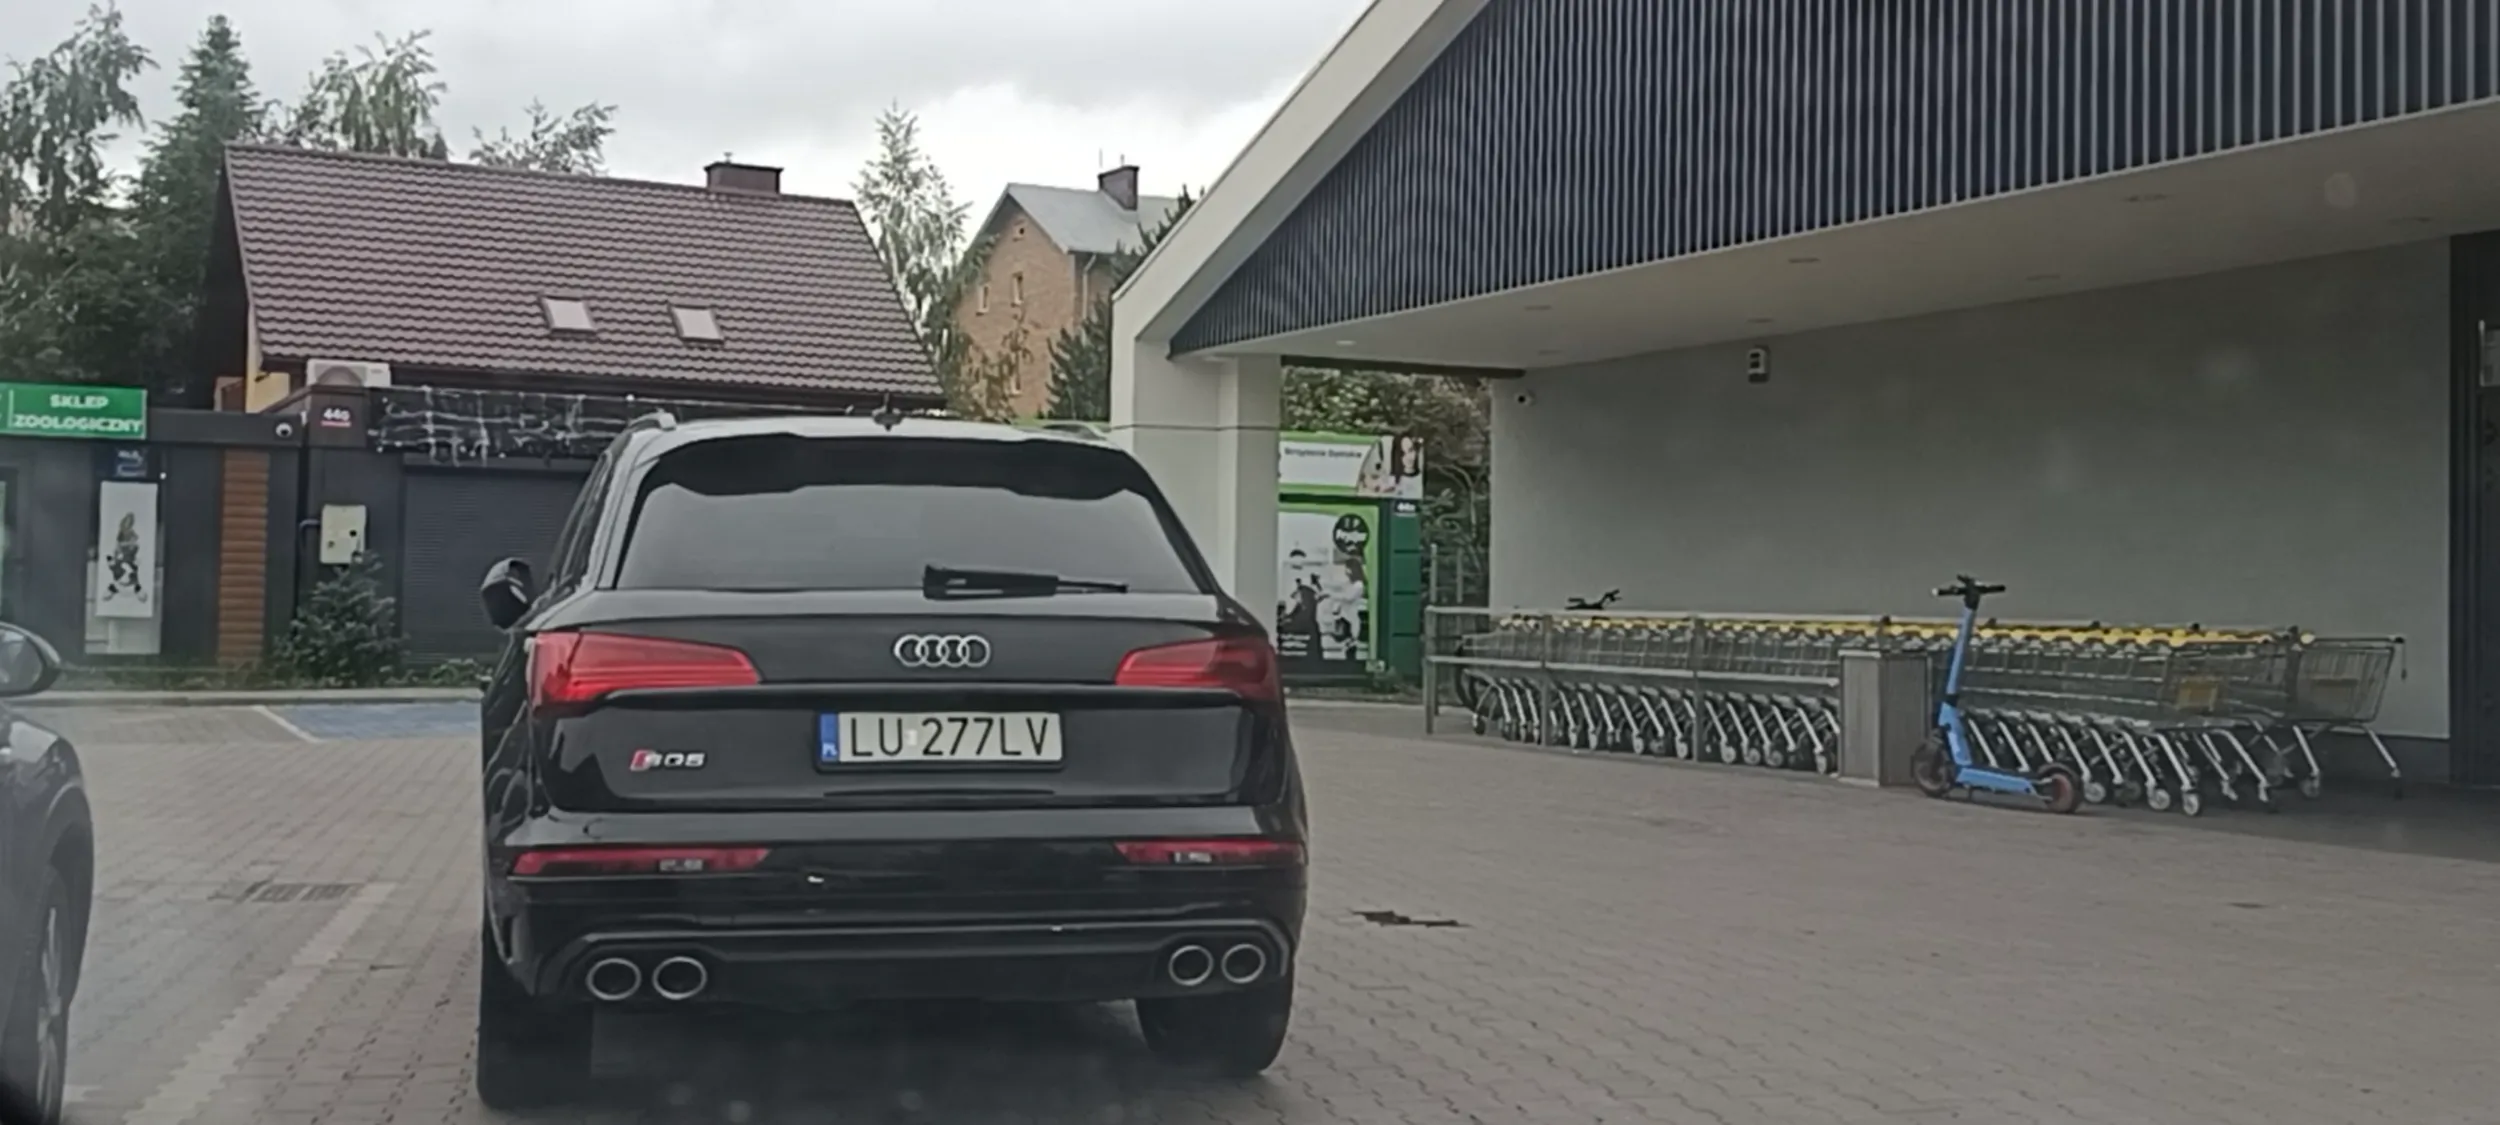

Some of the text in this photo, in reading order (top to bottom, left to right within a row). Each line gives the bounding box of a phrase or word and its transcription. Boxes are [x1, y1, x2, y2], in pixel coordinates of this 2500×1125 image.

[50, 394, 109, 409] SKLEP
[14, 414, 141, 432] ZOOLOGICZNY
[851, 717, 1048, 756] LU 277LV
